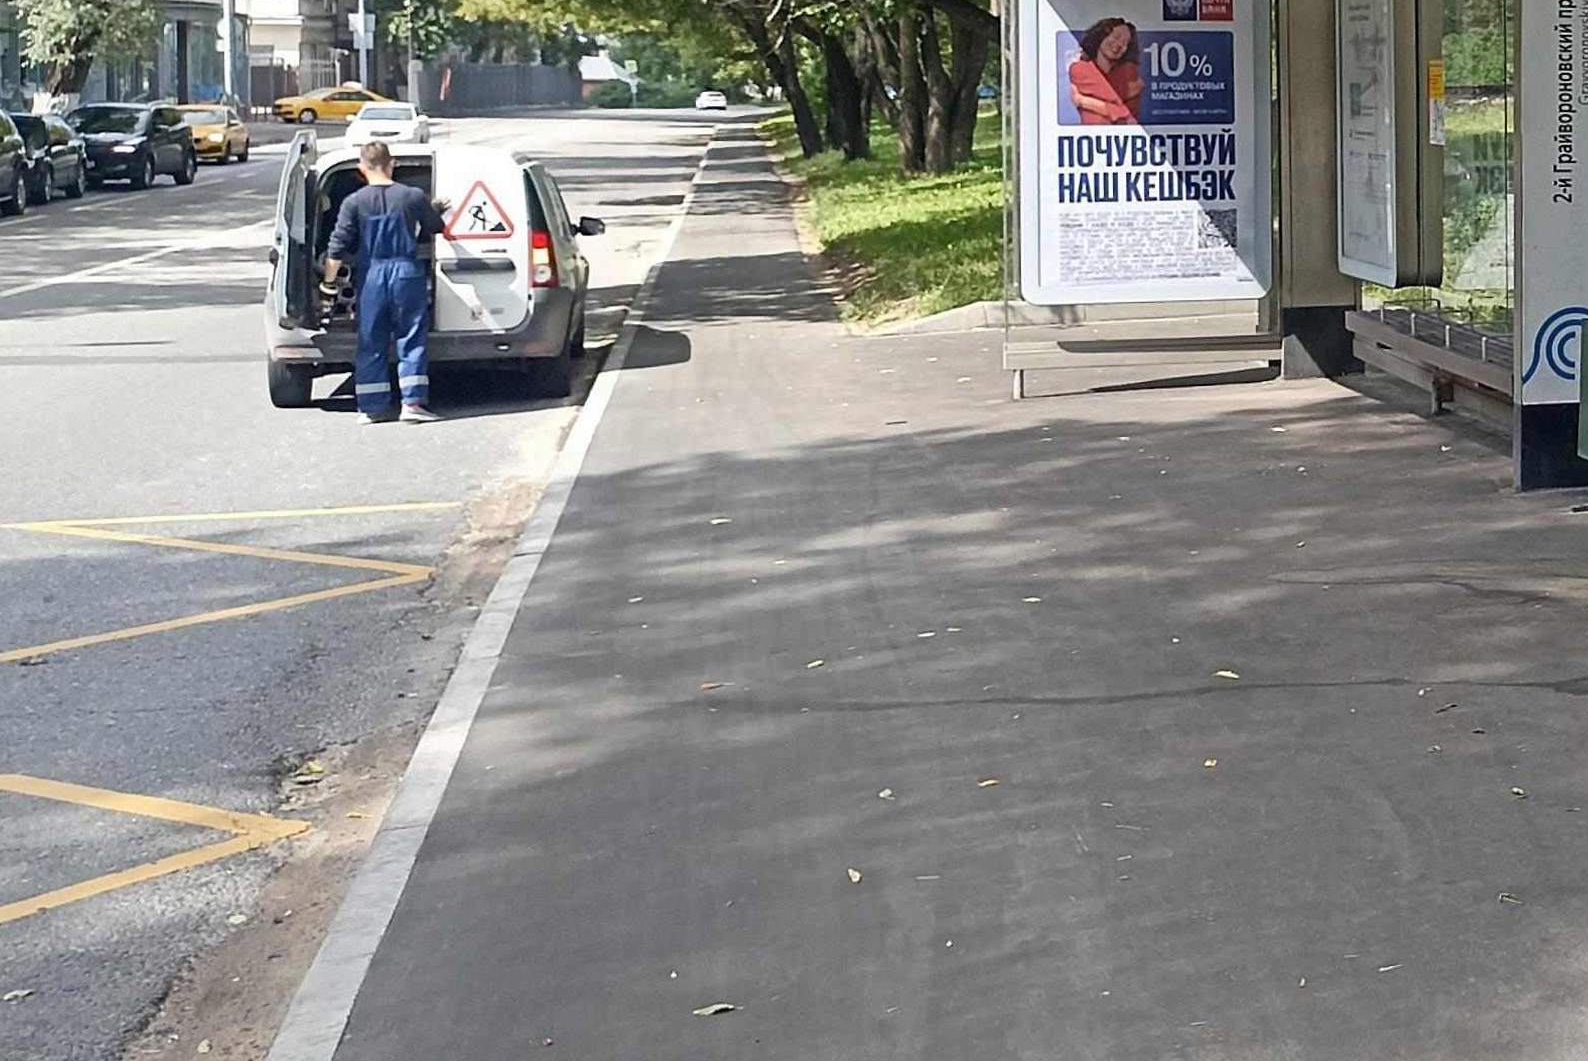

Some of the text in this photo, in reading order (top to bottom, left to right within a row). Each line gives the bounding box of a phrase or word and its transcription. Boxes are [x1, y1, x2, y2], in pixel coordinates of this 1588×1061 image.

[1143, 41, 1213, 77] 10 %
[1151, 91, 1205, 101] МАГАЗИНАХ
[1160, 82, 1225, 91] ПРОДУКТОВЫХ
[1553, 24, 1577, 174] Грайвороновский
[1057, 128, 1237, 168] ПОЧУВСТВУЙ
[1058, 169, 1237, 204] НАШ КЕШБЭК
[1553, 178, 1573, 203] 2-й
